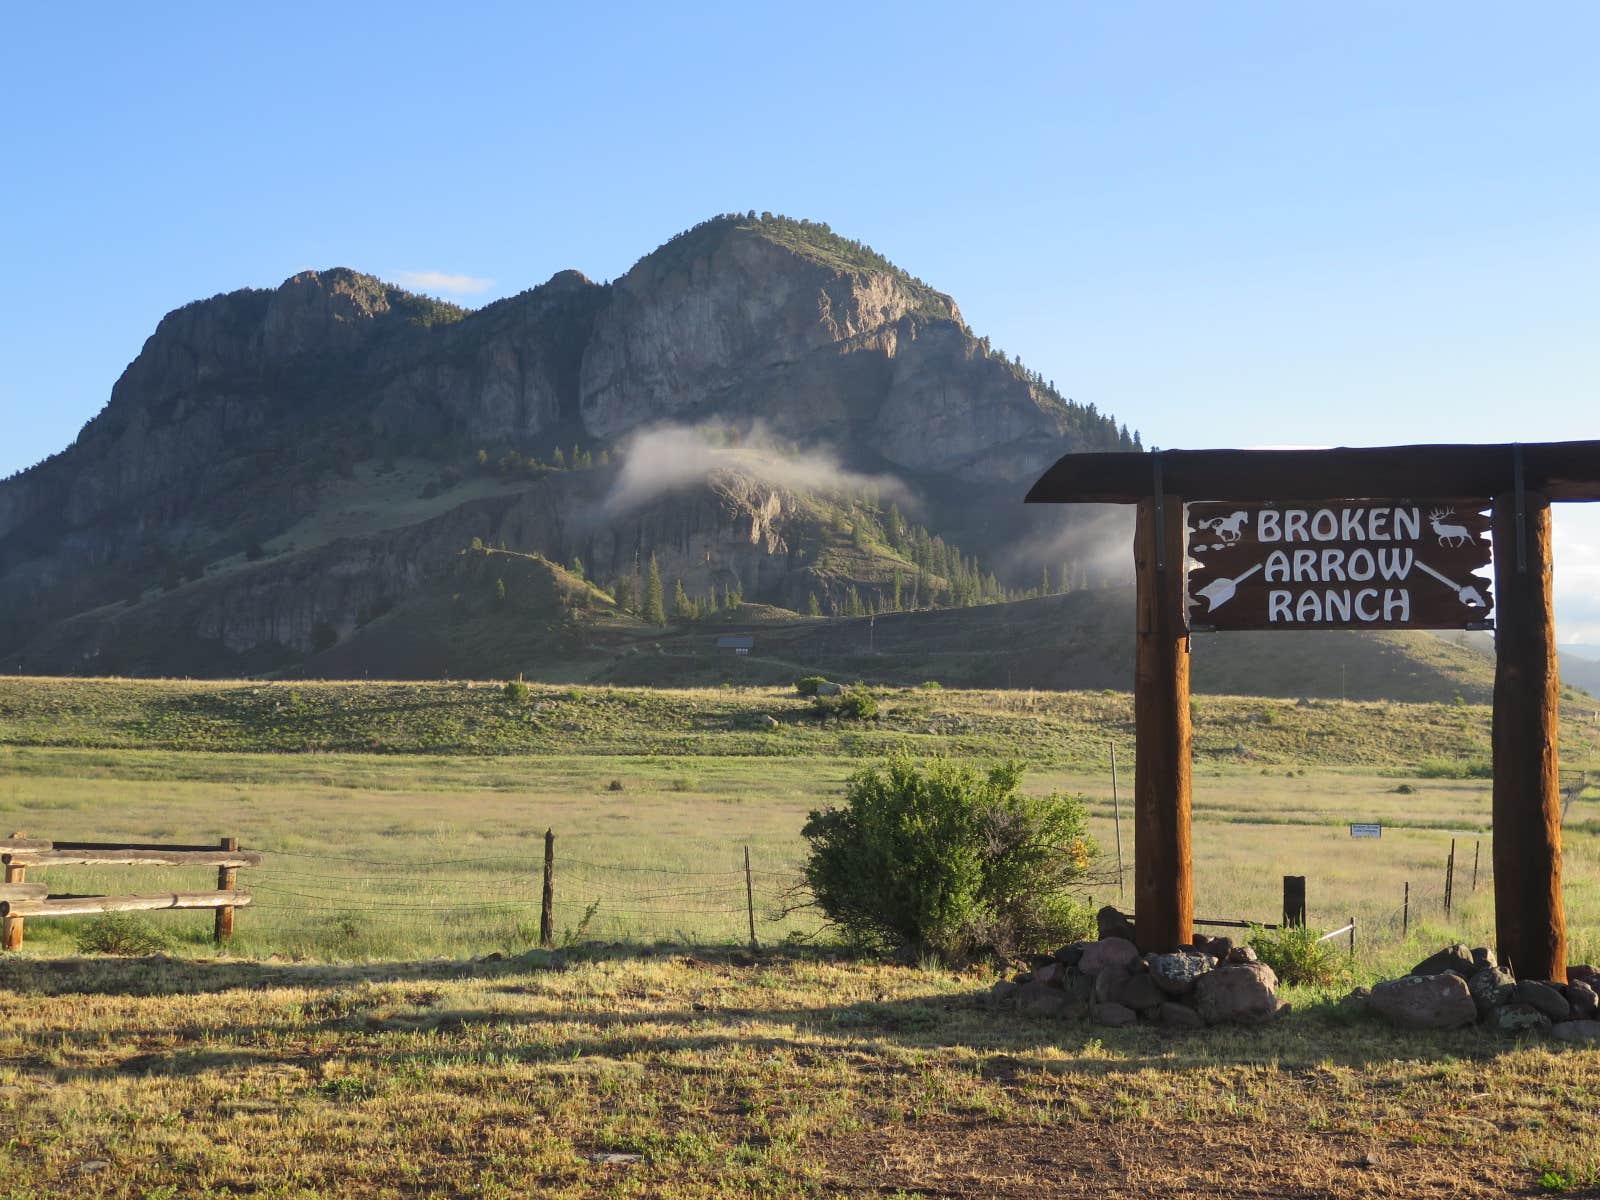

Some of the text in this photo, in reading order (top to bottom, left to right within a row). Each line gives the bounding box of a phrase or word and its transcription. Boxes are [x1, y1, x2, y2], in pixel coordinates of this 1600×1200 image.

[1257, 507, 1420, 542] BROKEN
[1264, 548, 1413, 582] ARROW
[1268, 588, 1410, 621] RANCH
